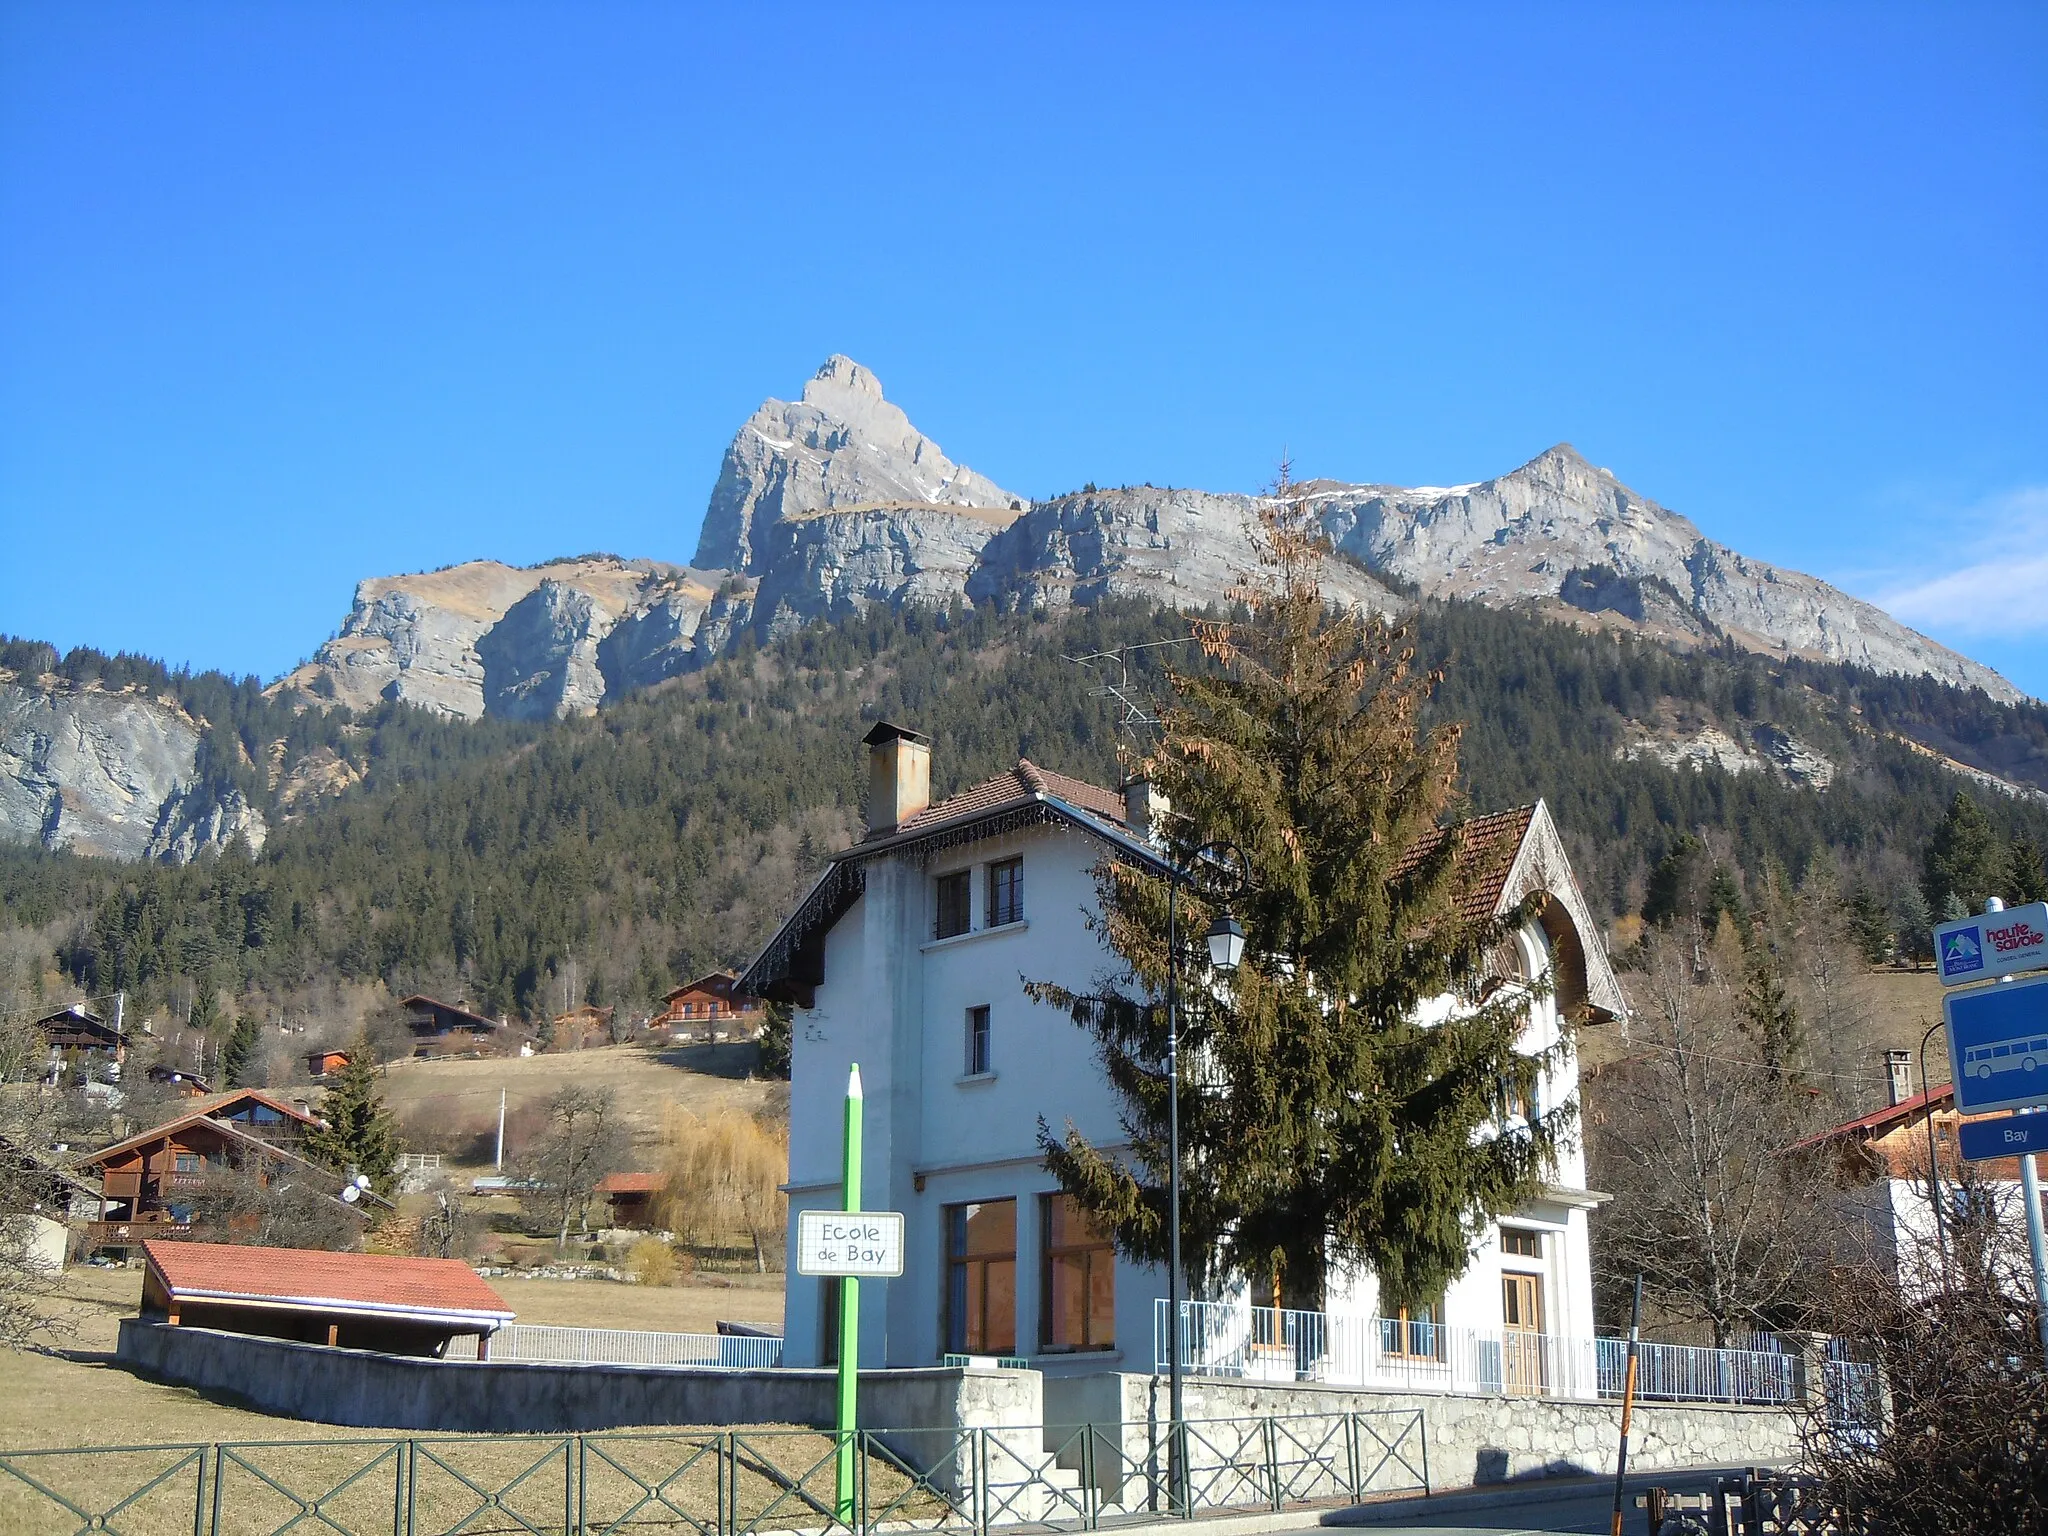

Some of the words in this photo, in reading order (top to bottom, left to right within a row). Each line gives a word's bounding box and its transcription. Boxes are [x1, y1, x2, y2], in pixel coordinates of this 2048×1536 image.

[1986, 923, 2028, 943] haute
[1996, 932, 2043, 952] savoie
[2003, 1129, 2028, 1143] Bay
[822, 1224, 880, 1241] Ecole
[818, 1248, 837, 1262] de
[847, 1245, 886, 1265] Bay
